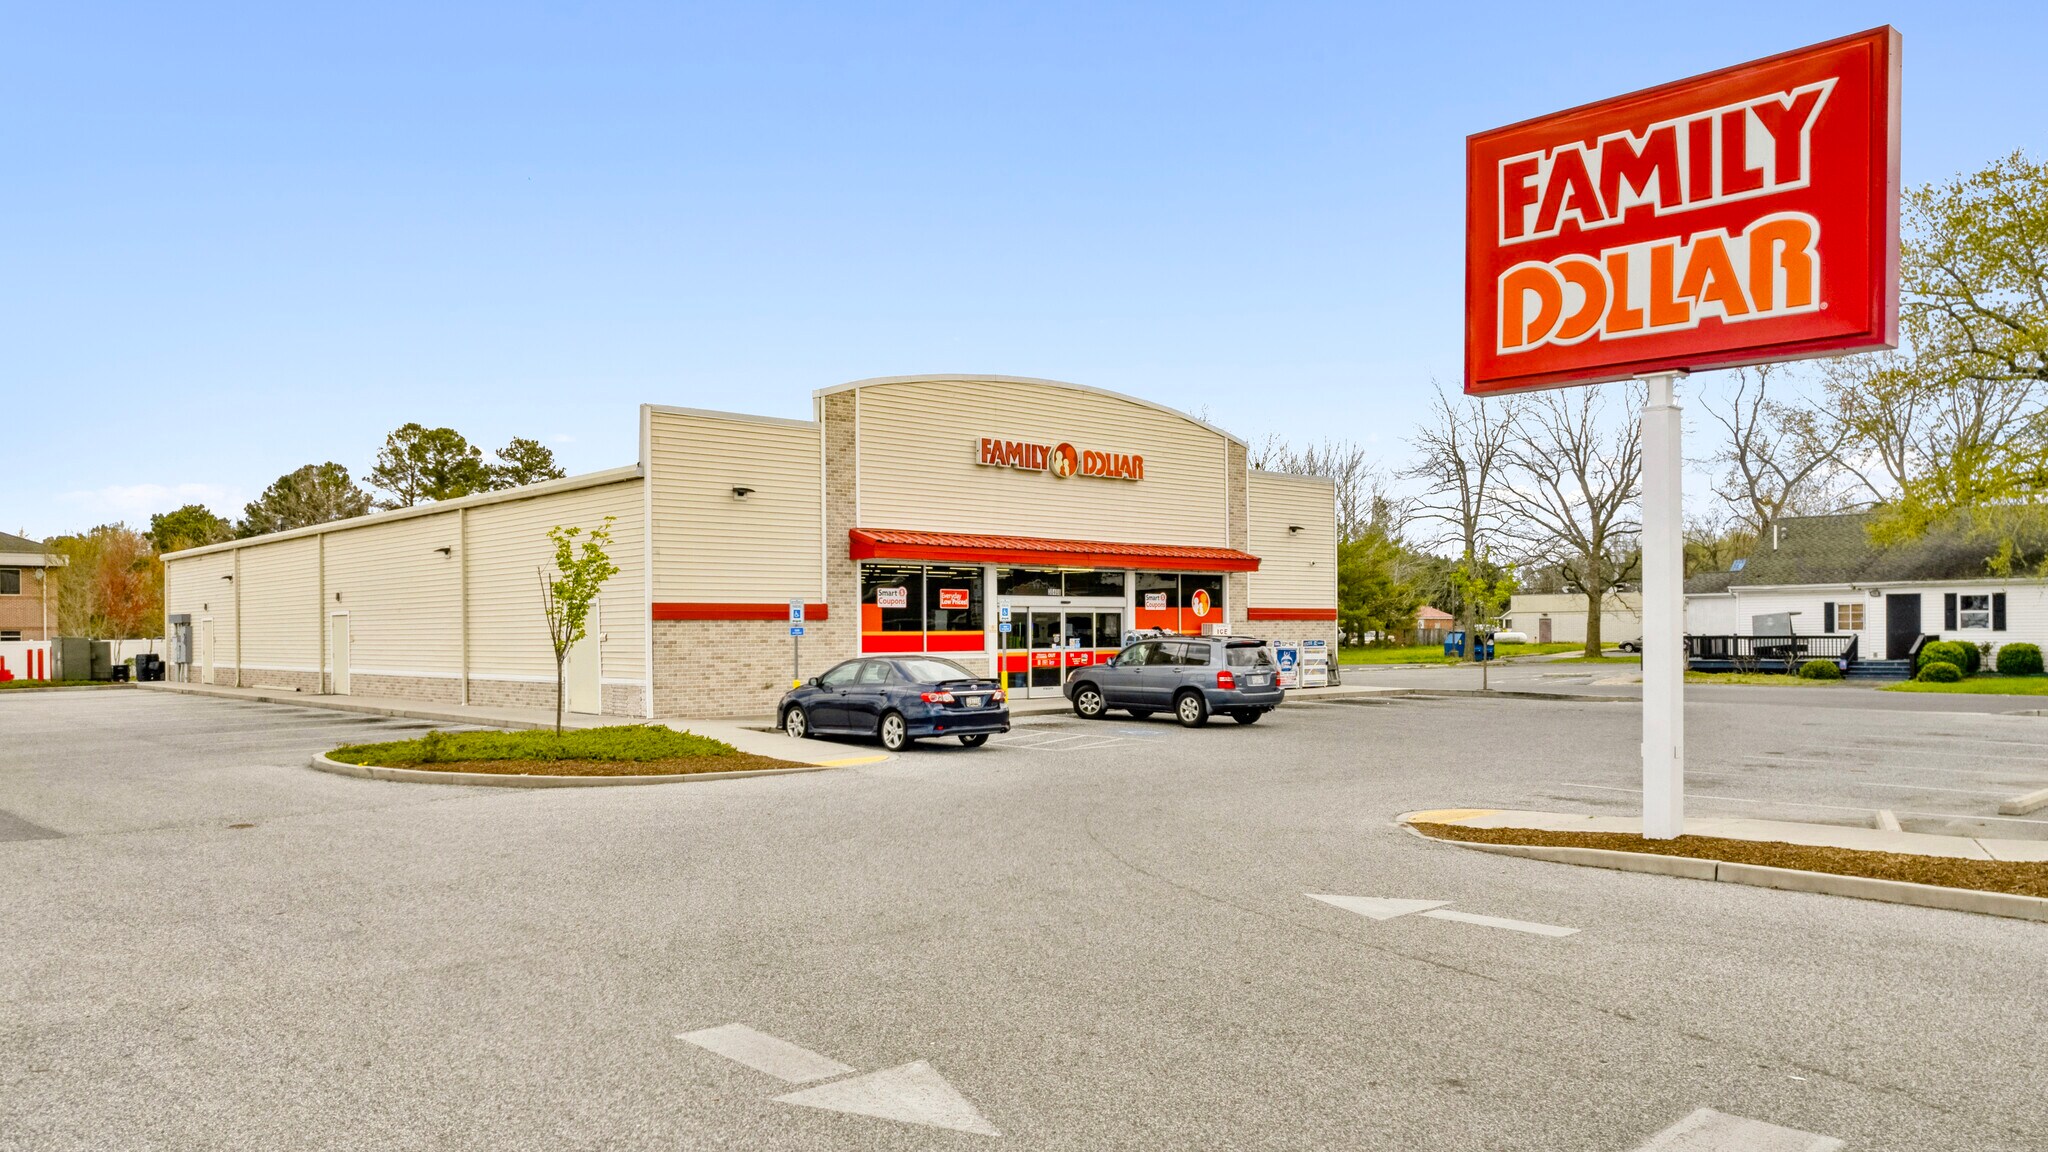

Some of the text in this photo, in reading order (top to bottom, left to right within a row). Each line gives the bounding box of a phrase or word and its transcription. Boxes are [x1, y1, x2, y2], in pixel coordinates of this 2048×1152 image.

[1498, 77, 1839, 247] FAMILY
[1497, 211, 1821, 356] DOLLAR
[979, 436, 1144, 480] FAMILY DOLLAR
[878, 589, 898, 597] Smart
[878, 597, 906, 606] Coupons
[1145, 601, 1166, 609] Coupons
